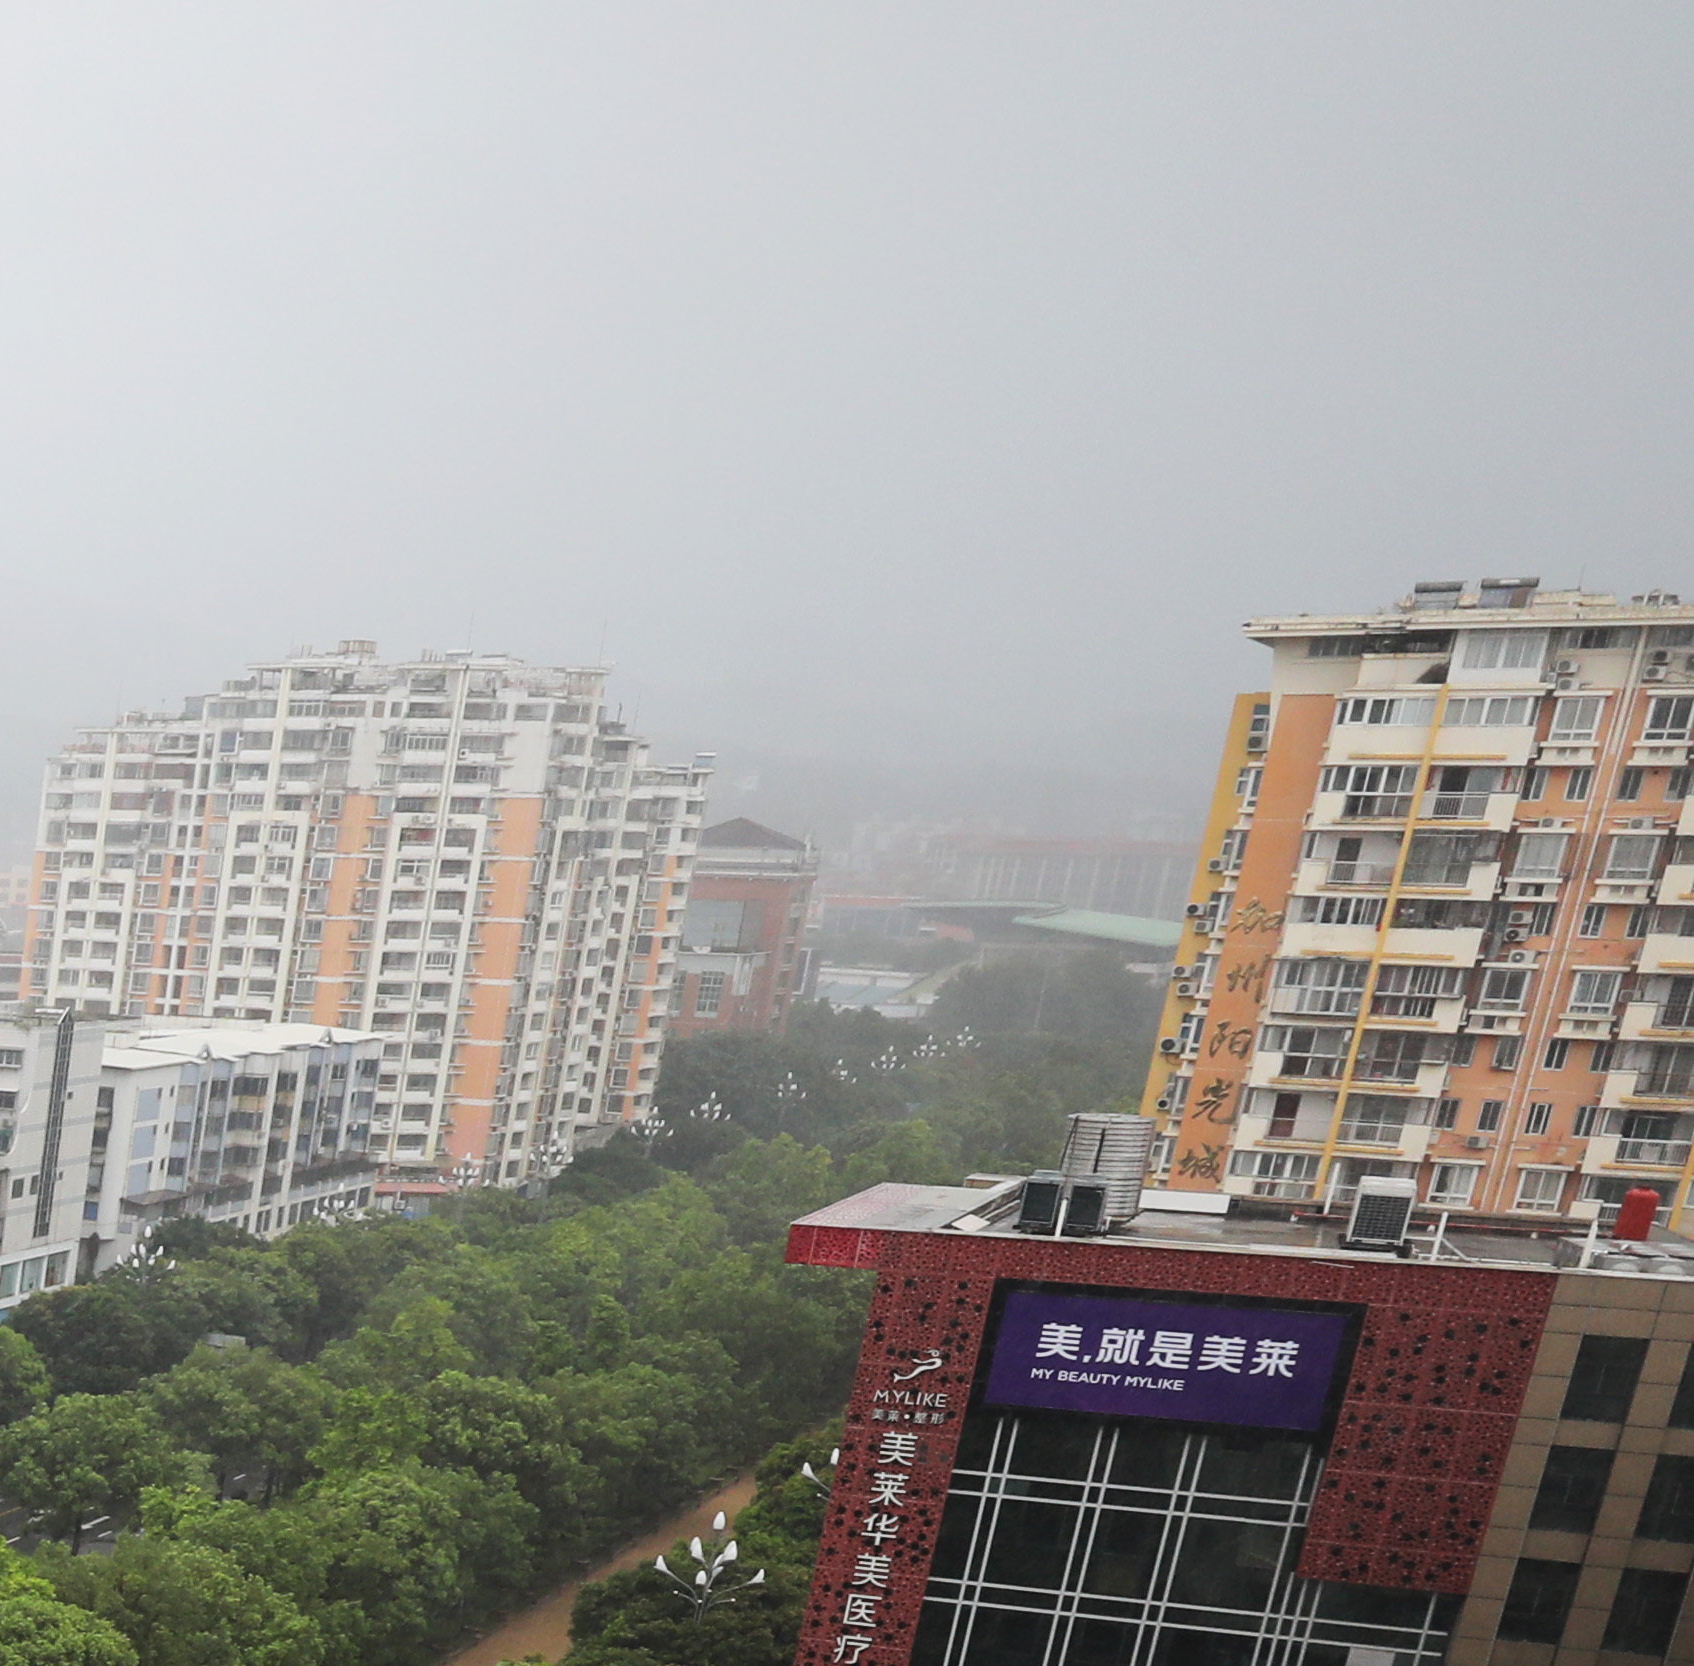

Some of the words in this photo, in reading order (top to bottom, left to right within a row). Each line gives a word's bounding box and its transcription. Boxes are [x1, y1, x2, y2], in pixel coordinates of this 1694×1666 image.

[1031, 1367, 1054, 1381] MY
[1057, 1370, 1122, 1386] BEAUTY
[1124, 1375, 1185, 1391] MYLIKE
[873, 1389, 949, 1409] MYLIKE
